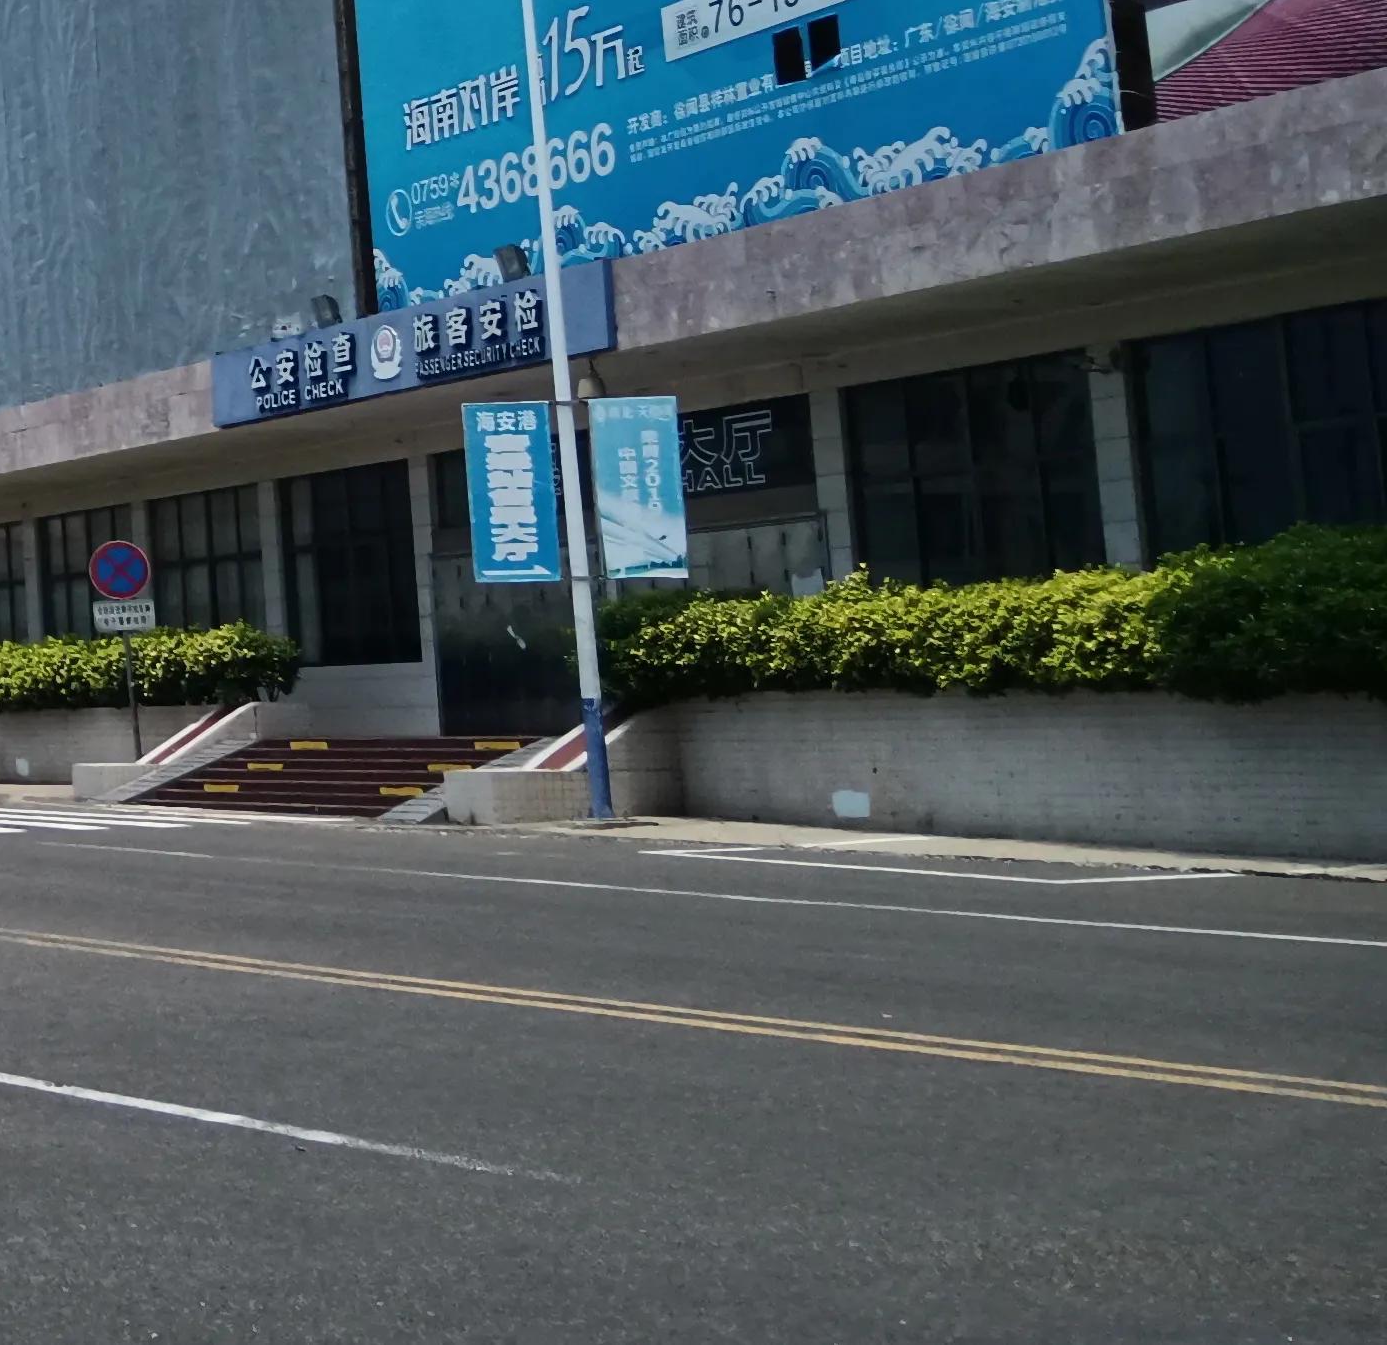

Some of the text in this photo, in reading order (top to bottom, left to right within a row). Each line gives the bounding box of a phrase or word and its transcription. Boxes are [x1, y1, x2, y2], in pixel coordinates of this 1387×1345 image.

[403, 63, 521, 151] 海南对岸
[412, 290, 540, 354] 旅客安检
[249, 332, 352, 390] 公安检查
[255, 377, 344, 411] POLICE CHECK
[476, 409, 538, 433] 海安港
